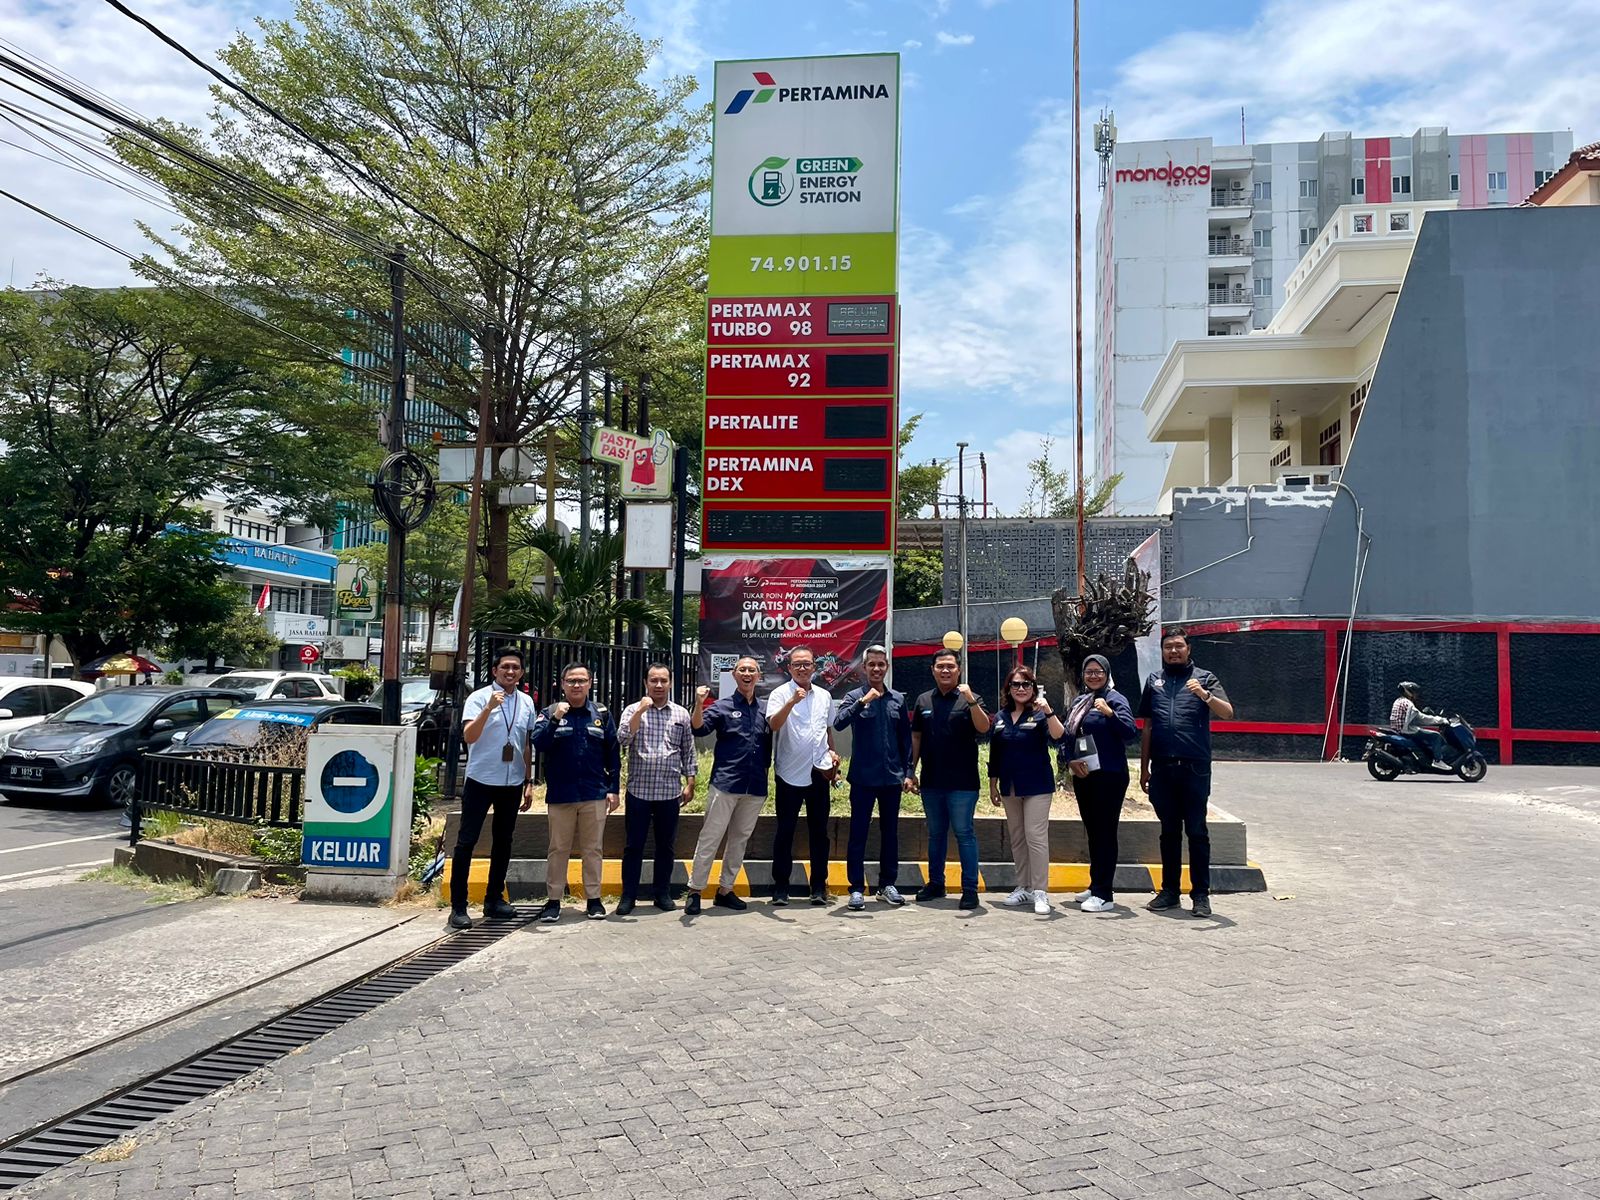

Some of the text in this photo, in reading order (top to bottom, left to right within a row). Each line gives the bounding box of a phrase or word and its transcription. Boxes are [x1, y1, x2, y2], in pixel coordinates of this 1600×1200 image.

[779, 84, 889, 102] PERTAMINA
[800, 158, 849, 172] GREEN
[1116, 160, 1210, 185] monoloog
[800, 175, 858, 189] ENERGY
[1167, 178, 1198, 187] HOTEL
[799, 190, 861, 204] STATION
[750, 255, 852, 272] 74.901.15
[711, 302, 812, 318] PERTAMAX
[711, 320, 812, 336] TURBO 98
[710, 354, 811, 369] PERTAMAX
[787, 373, 811, 388] 92
[708, 415, 798, 430] PERTALITE
[600, 431, 637, 450] PASTI
[601, 444, 630, 460] PAS!
[707, 457, 814, 472] PERTAMINA
[706, 476, 744, 491] DEX
[742, 601, 839, 611] GRATIS NONTON
[304, 629, 327, 637] RAHAR
[311, 840, 381, 862] KELUAR
